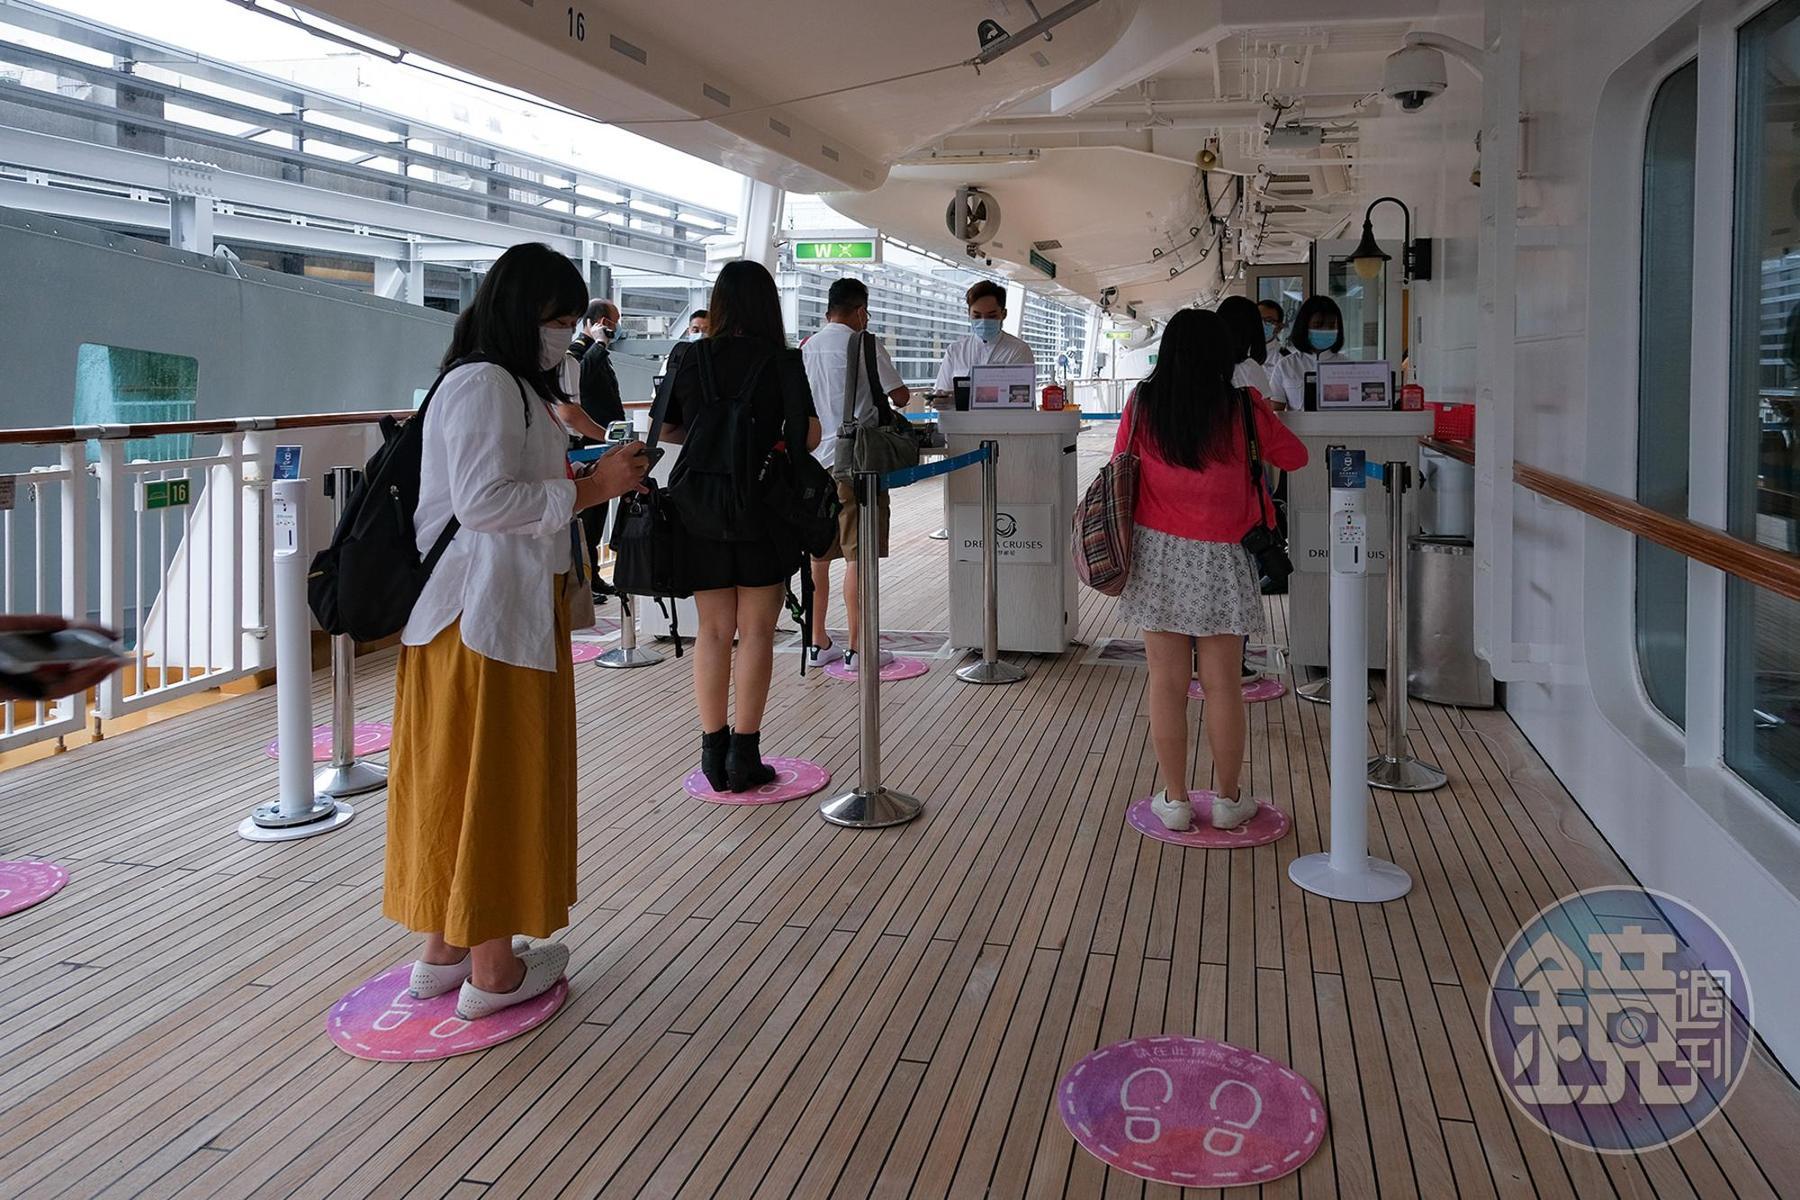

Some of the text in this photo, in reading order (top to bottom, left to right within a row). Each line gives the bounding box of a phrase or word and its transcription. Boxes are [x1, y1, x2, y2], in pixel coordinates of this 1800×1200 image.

[567, 7, 585, 42] 16
[814, 243, 833, 258] W
[173, 484, 187, 502] 16
[964, 540, 1043, 550] DRE CRUISES
